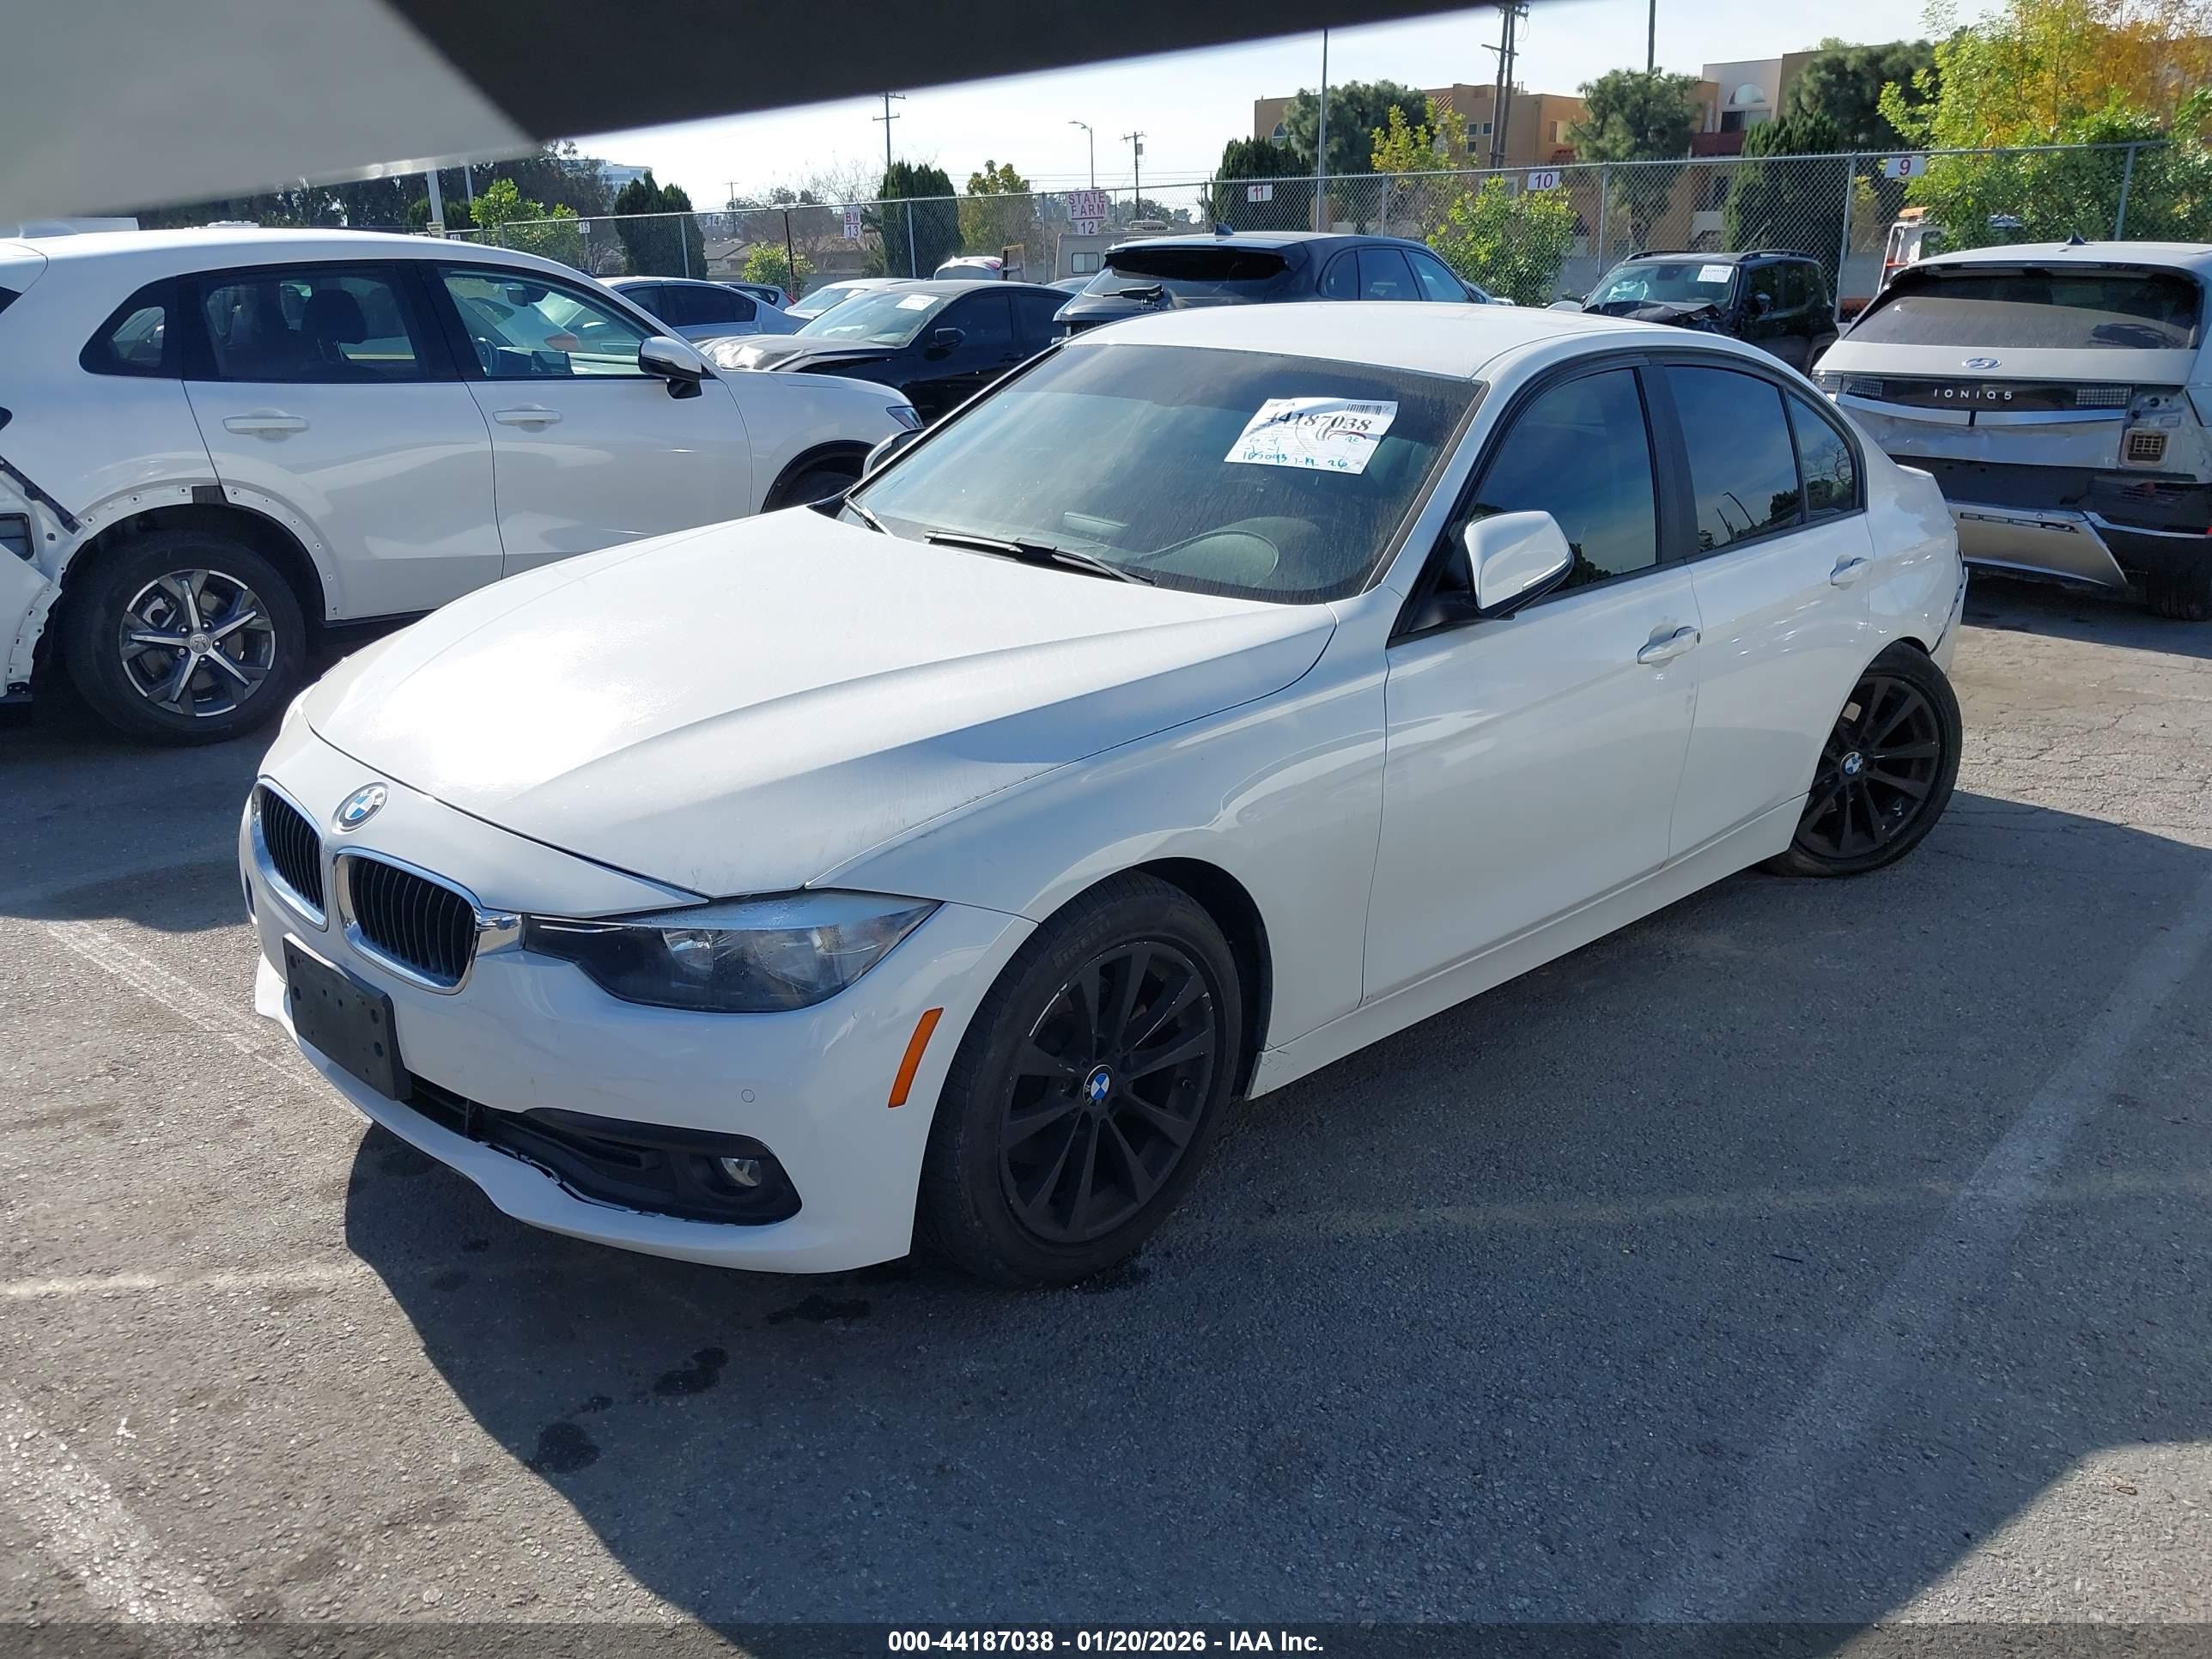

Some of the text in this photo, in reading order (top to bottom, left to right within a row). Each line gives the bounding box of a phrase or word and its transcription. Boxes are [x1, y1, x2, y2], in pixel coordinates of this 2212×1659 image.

[1899, 158, 1911, 176] 9
[1534, 173, 1553, 189] 10
[1068, 191, 1105, 205] STATE
[1253, 186, 1263, 201] 11
[1071, 204, 1105, 216] FARM
[846, 212, 859, 222] BW
[847, 225, 859, 237] 13
[1080, 221, 1095, 234] 12
[1934, 388, 2013, 400] IONIQ 5
